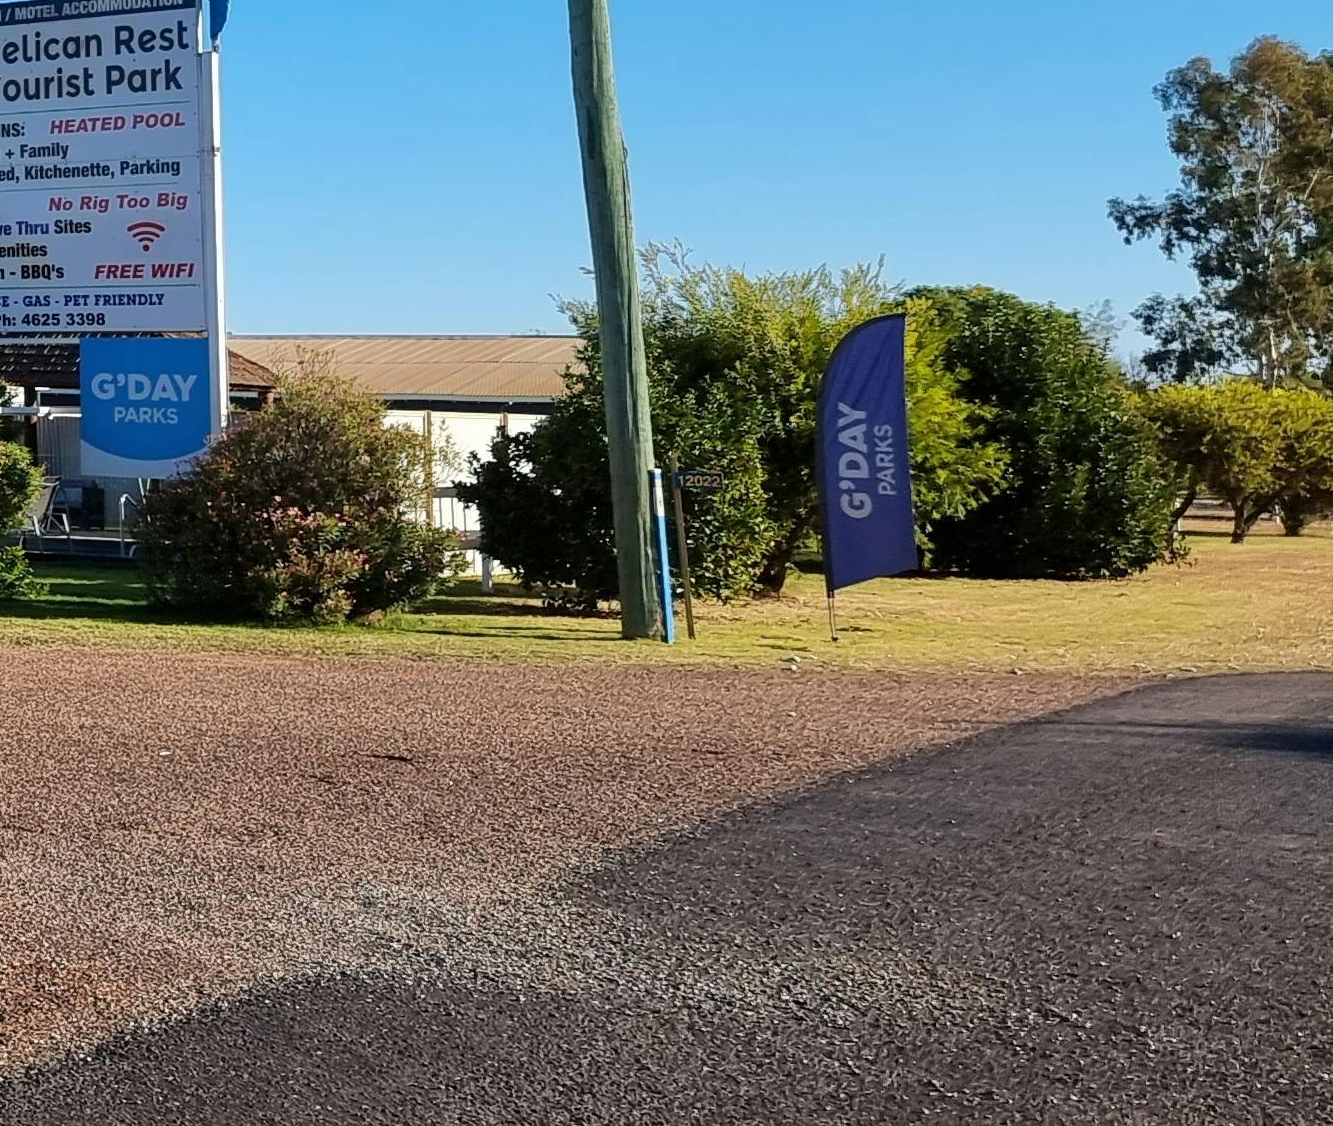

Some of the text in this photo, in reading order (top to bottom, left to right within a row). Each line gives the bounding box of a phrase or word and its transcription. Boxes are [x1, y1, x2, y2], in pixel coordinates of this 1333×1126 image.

[14, 3, 58, 20] MOTEL
[114, 19, 190, 56] Rest
[105, 58, 183, 94] Park
[50, 111, 186, 134] HEATED POOL
[4, 148, 15, 160] +
[19, 141, 69, 159] Family
[24, 161, 115, 181] Kitchenette,
[119, 158, 181, 176] Parking
[48, 191, 188, 213] No Rig Too Big
[15, 220, 50, 236] Thru
[53, 219, 92, 235] Sites
[20, 263, 65, 280] BBQ's
[94, 262, 195, 279] FREE WIFI
[22, 294, 51, 307] GAS
[63, 294, 90, 307] PET
[94, 293, 165, 307] FRIENDLY
[21, 313, 61, 327] 4625
[65, 312, 106, 326] 3398
[91, 372, 198, 403] G'DAY
[113, 406, 180, 426] PARKS
[836, 402, 873, 520] G'DAY
[873, 424, 898, 496] PARKS
